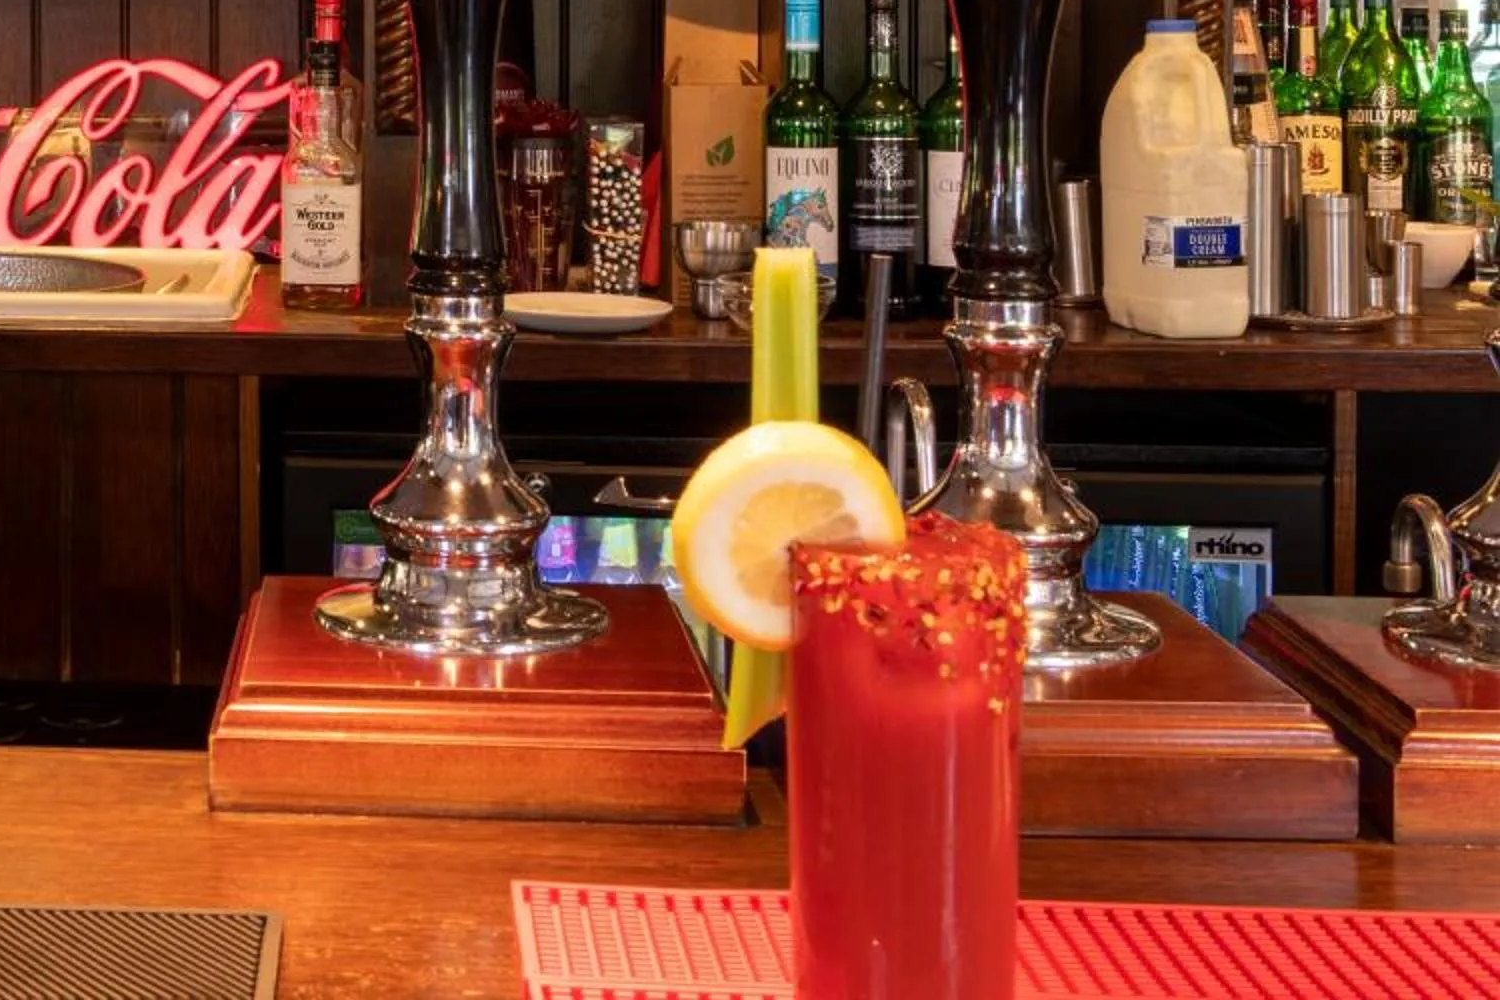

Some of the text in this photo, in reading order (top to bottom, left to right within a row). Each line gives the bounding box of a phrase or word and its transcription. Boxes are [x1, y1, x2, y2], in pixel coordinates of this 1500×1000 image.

[1285, 123, 1340, 140] AMESO
[307, 220, 335, 231] GOLD
[1189, 233, 1227, 245] DOUBLE
[1191, 244, 1226, 255] CREAM
[1196, 533, 1264, 556] rhino
